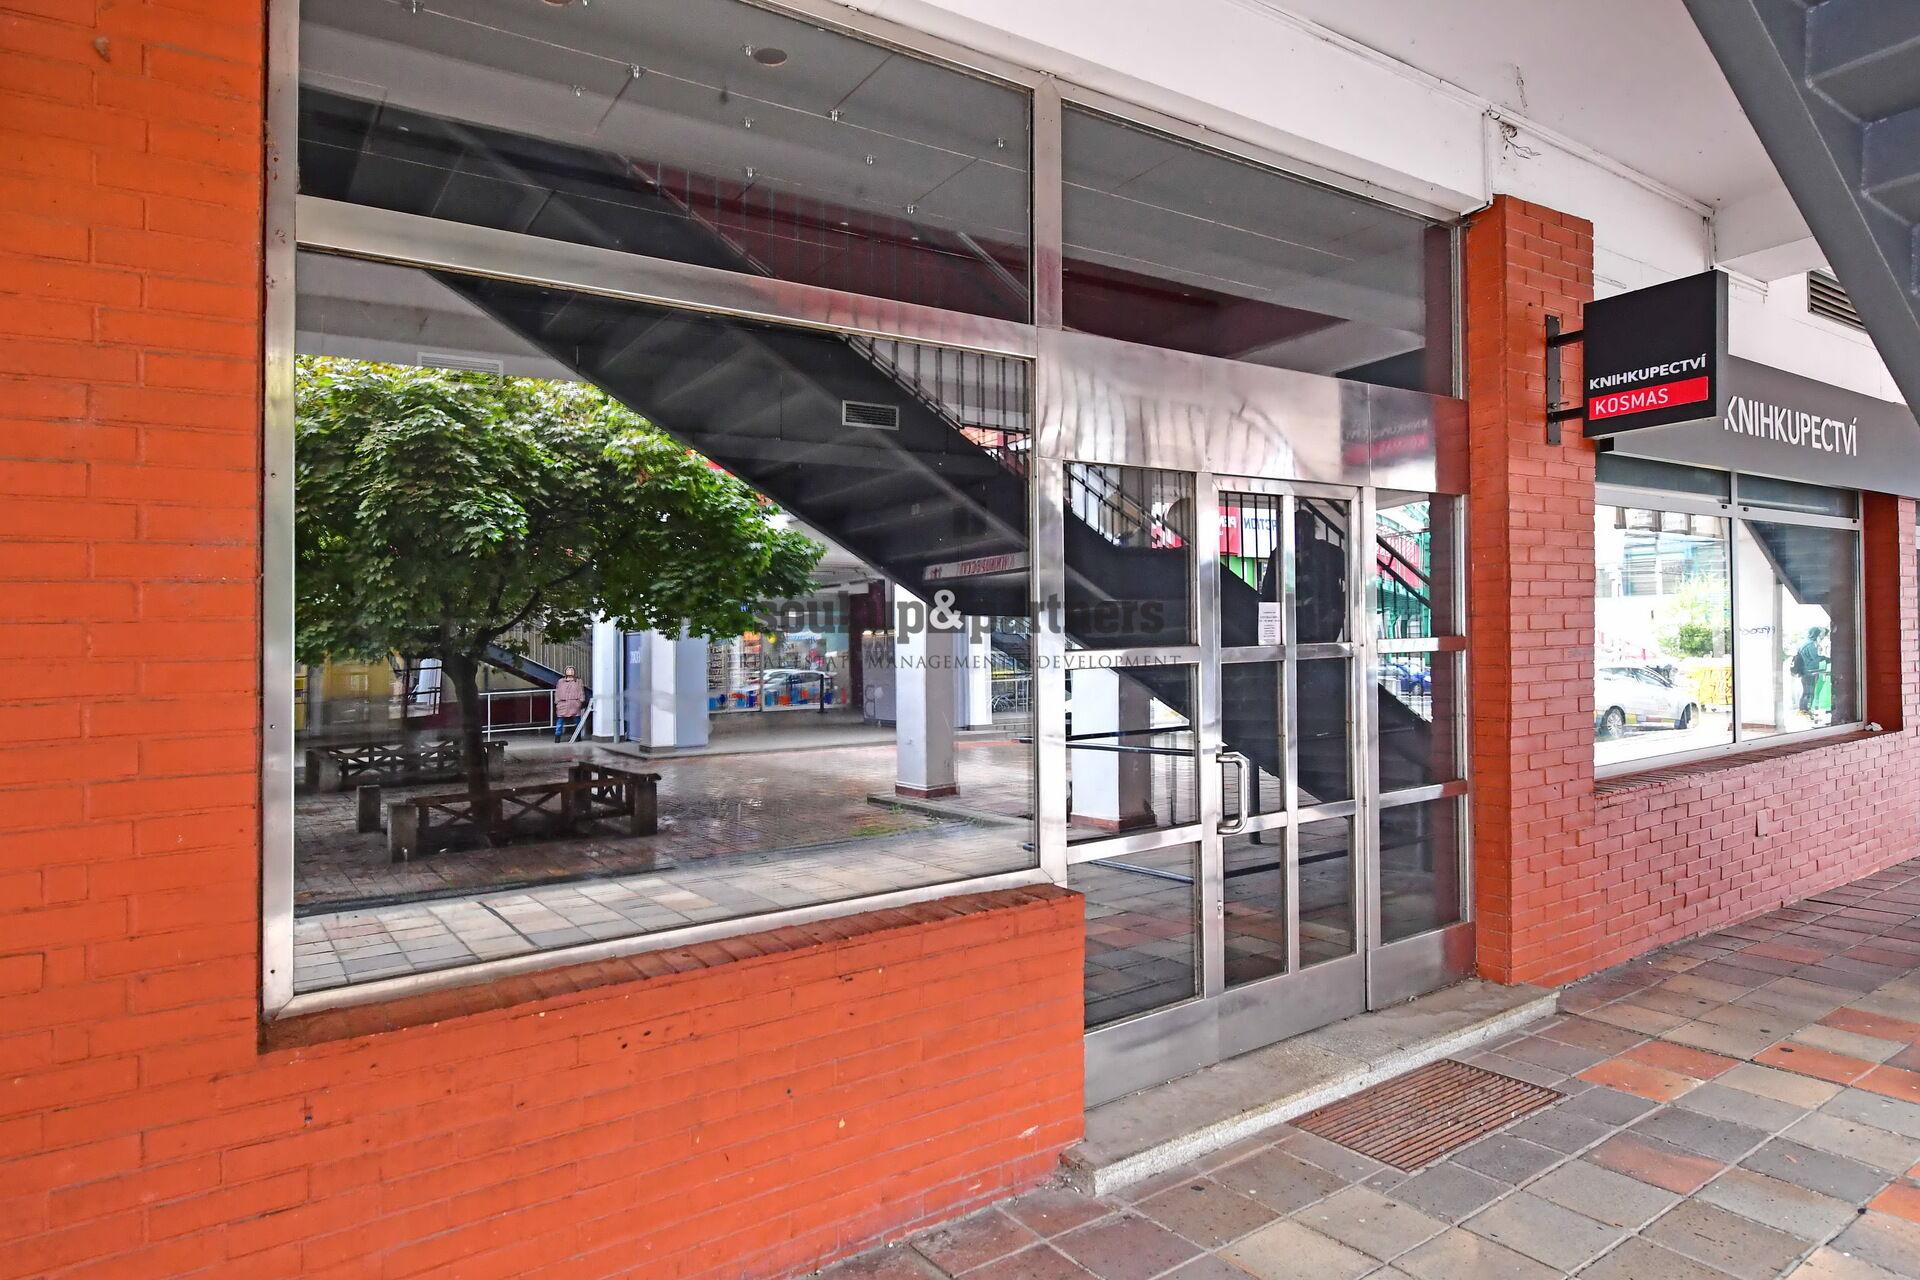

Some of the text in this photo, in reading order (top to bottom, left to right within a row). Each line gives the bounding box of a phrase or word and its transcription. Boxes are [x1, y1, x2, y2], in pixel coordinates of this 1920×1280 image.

[1589, 353, 1706, 390] KNIHKUPECTVÍ
[1595, 388, 1669, 415] KOSMAS
[1723, 396, 1858, 456] KNIHKUPECTVÍ
